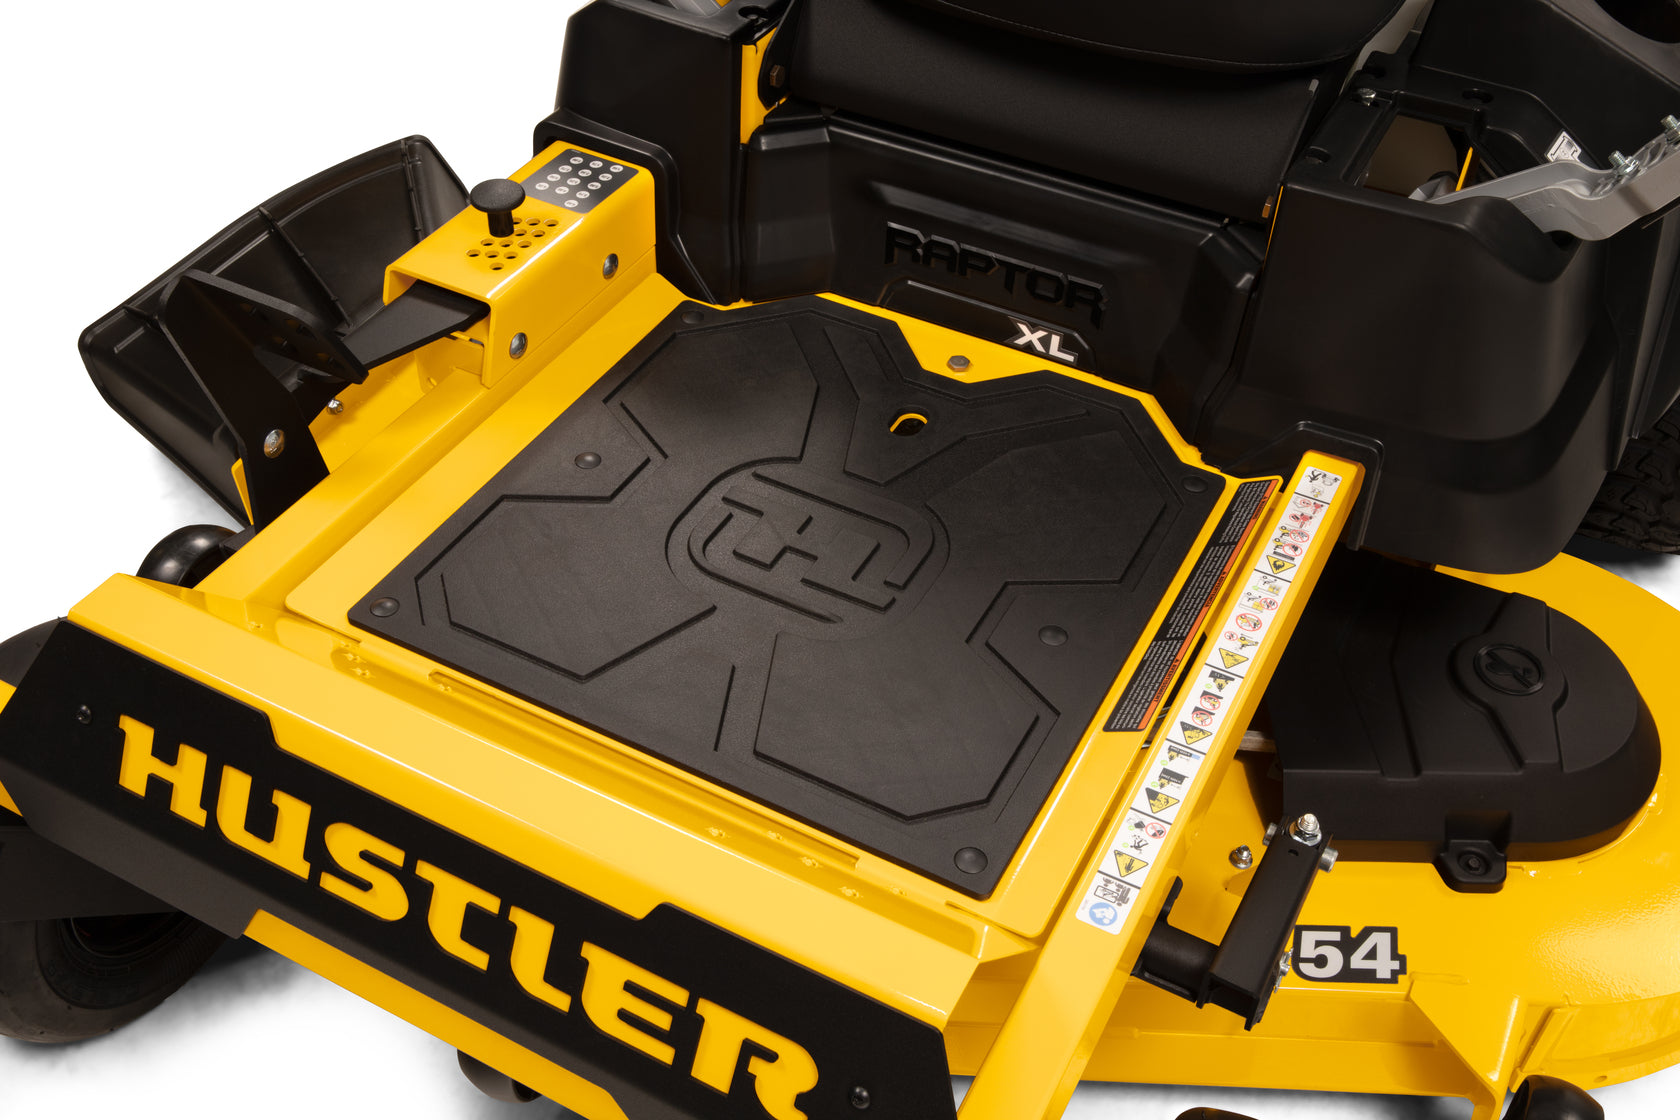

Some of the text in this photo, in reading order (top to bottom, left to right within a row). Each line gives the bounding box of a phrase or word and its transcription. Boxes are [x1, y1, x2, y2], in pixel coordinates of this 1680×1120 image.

[884, 221, 1108, 330] RAPTOR
[1014, 322, 1075, 362] XL
[117, 714, 820, 1119] HUSTLER
[1298, 930, 1400, 979] 54
